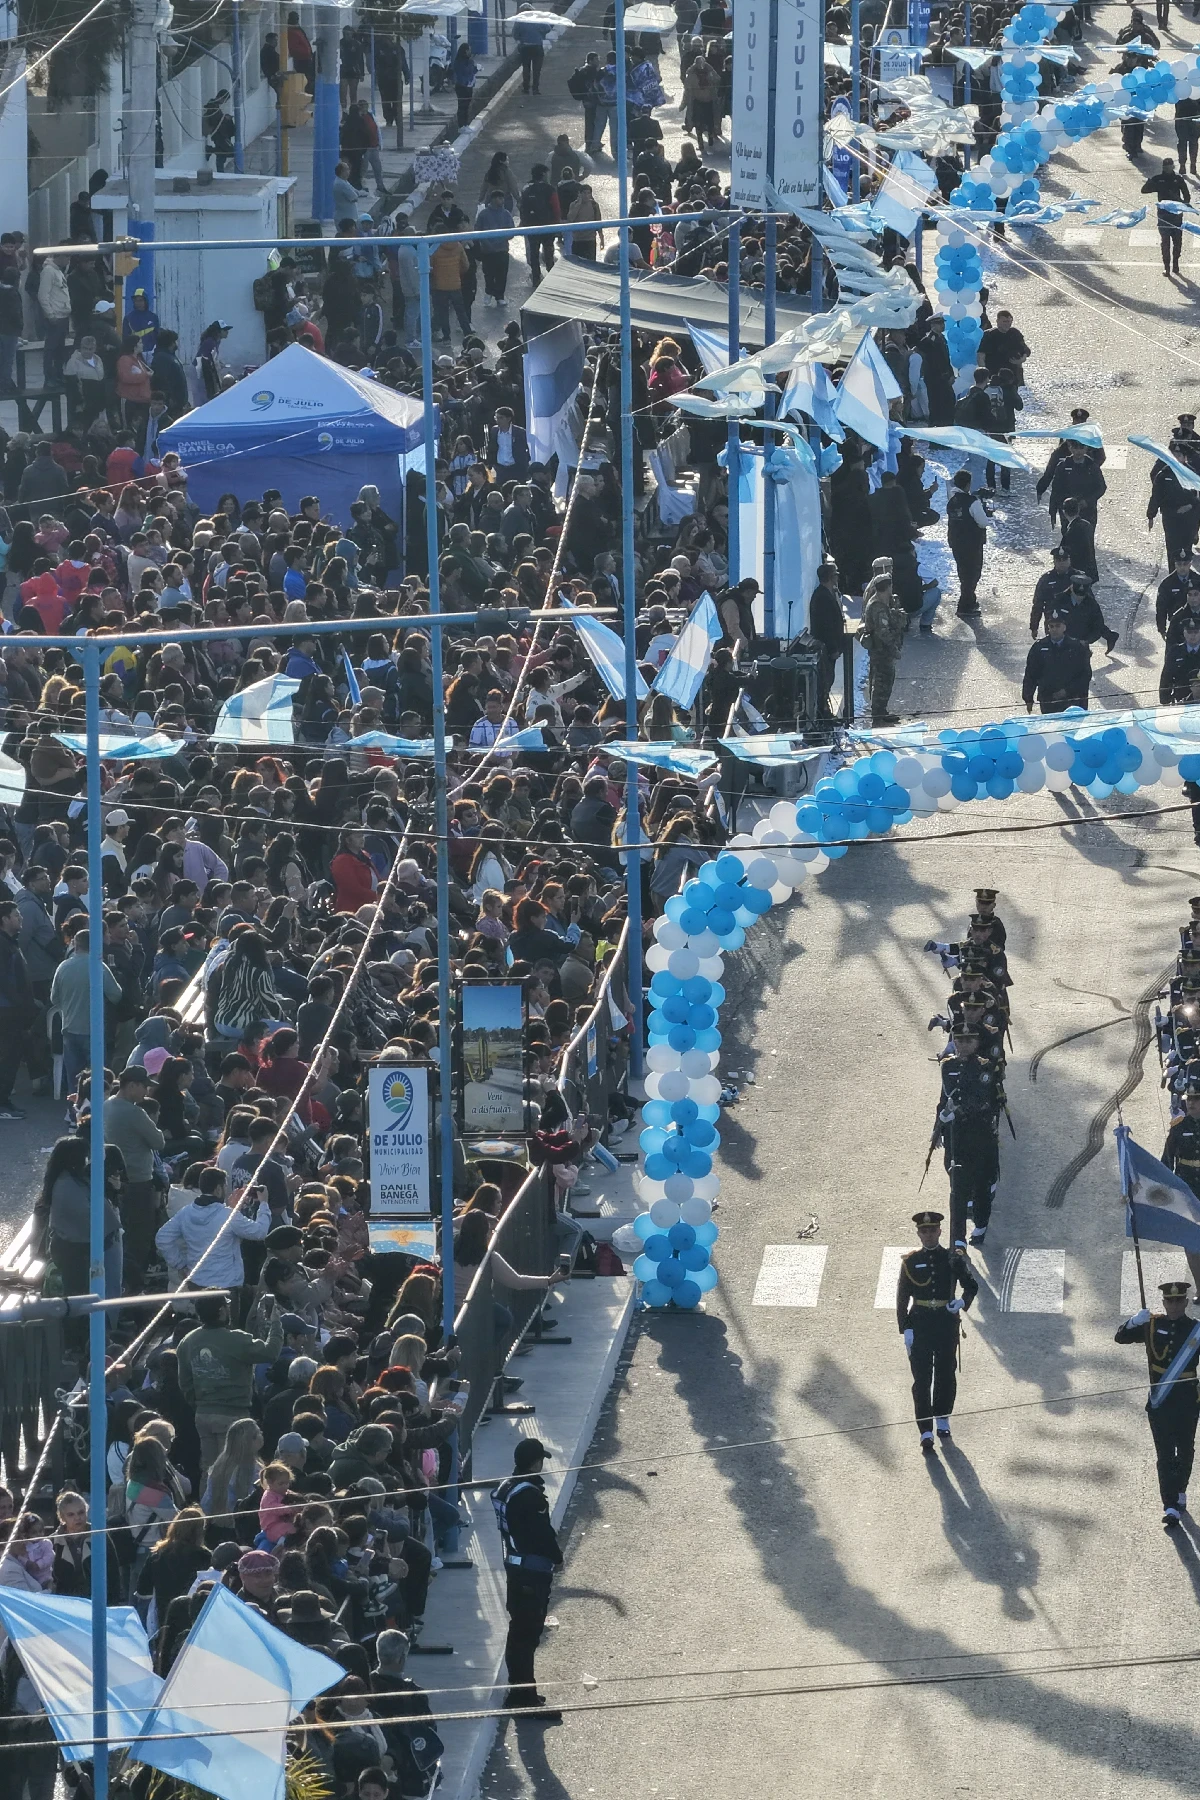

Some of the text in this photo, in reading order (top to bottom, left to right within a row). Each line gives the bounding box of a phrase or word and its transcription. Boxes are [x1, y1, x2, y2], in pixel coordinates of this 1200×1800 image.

[745, 11, 757, 112] JULIO
[792, 19, 805, 139] JULIO
[293, 400, 324, 408] JULIO
[178, 443, 236, 454] BANEGA
[374, 1133, 423, 1147] DE JULIO
[374, 1147, 424, 1156] MUNICIPALIDAD
[378, 1162, 421, 1177] Vivir Bien
[380, 1183, 418, 1191] DANIEL
[380, 1190, 419, 1200] BANEGA
